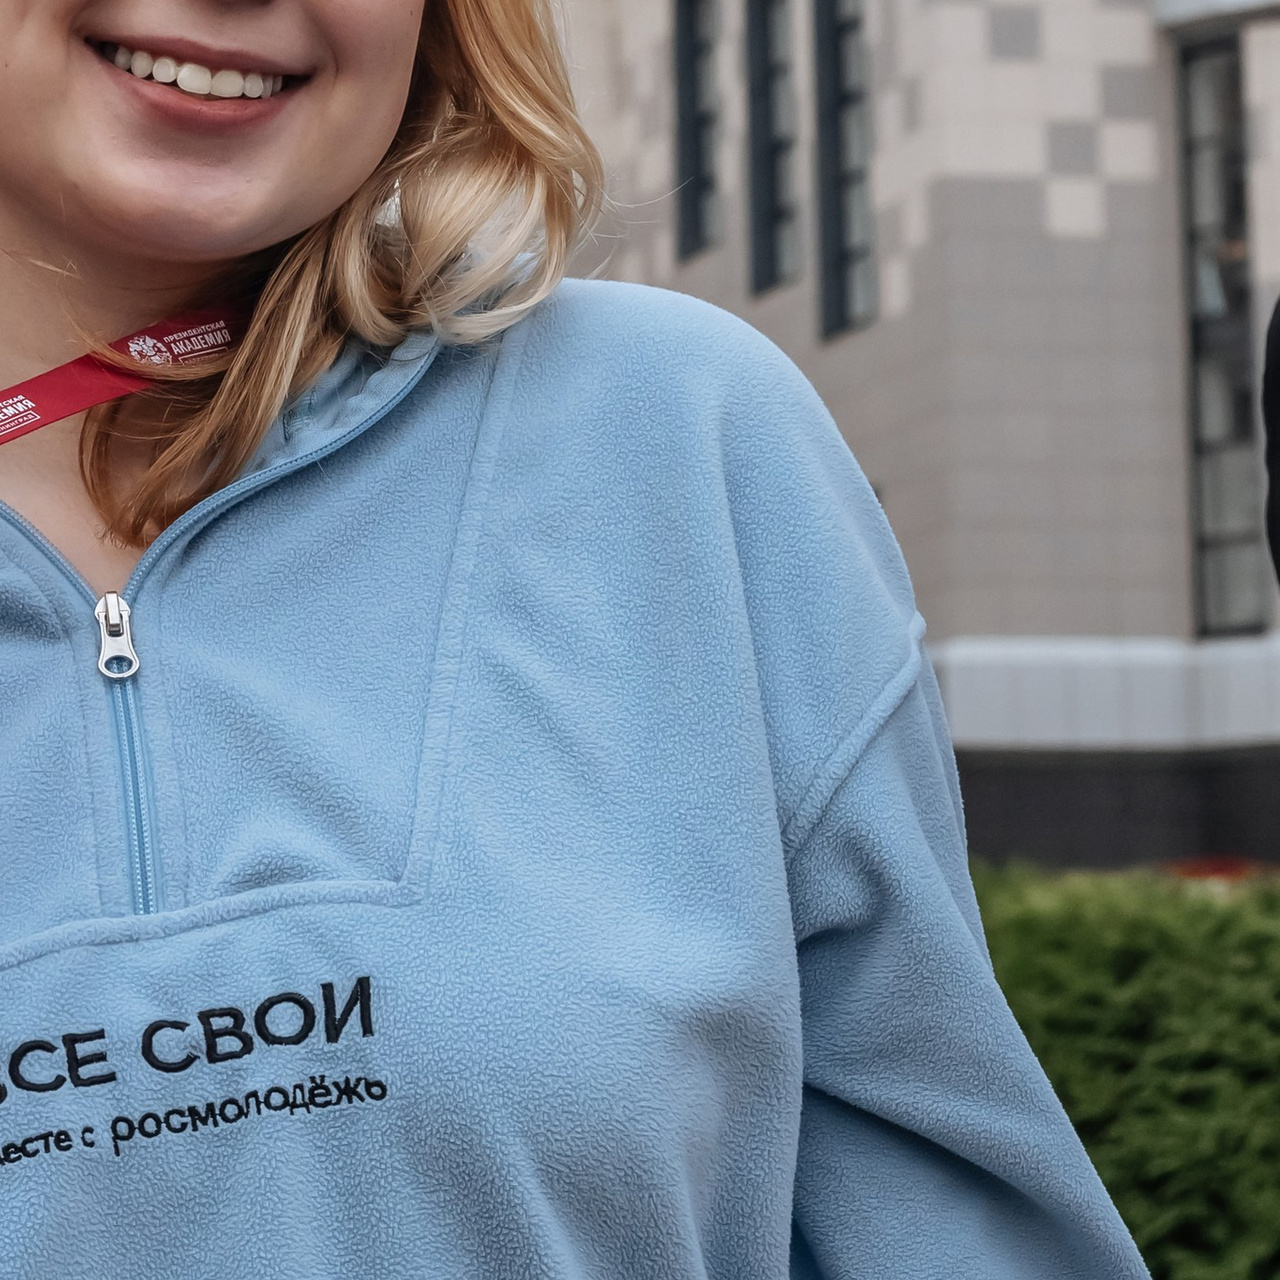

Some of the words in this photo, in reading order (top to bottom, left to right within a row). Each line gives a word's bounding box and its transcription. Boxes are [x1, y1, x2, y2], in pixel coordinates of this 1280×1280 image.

[163, 320, 225, 343] ПРЕЗИДЕНТСКАЯ
[170, 329, 231, 355] АКАДЕМИЯ
[141, 976, 375, 1073] СВОИ
[81, 1126, 95, 1148] с
[111, 1074, 387, 1156] росмолодёжь
